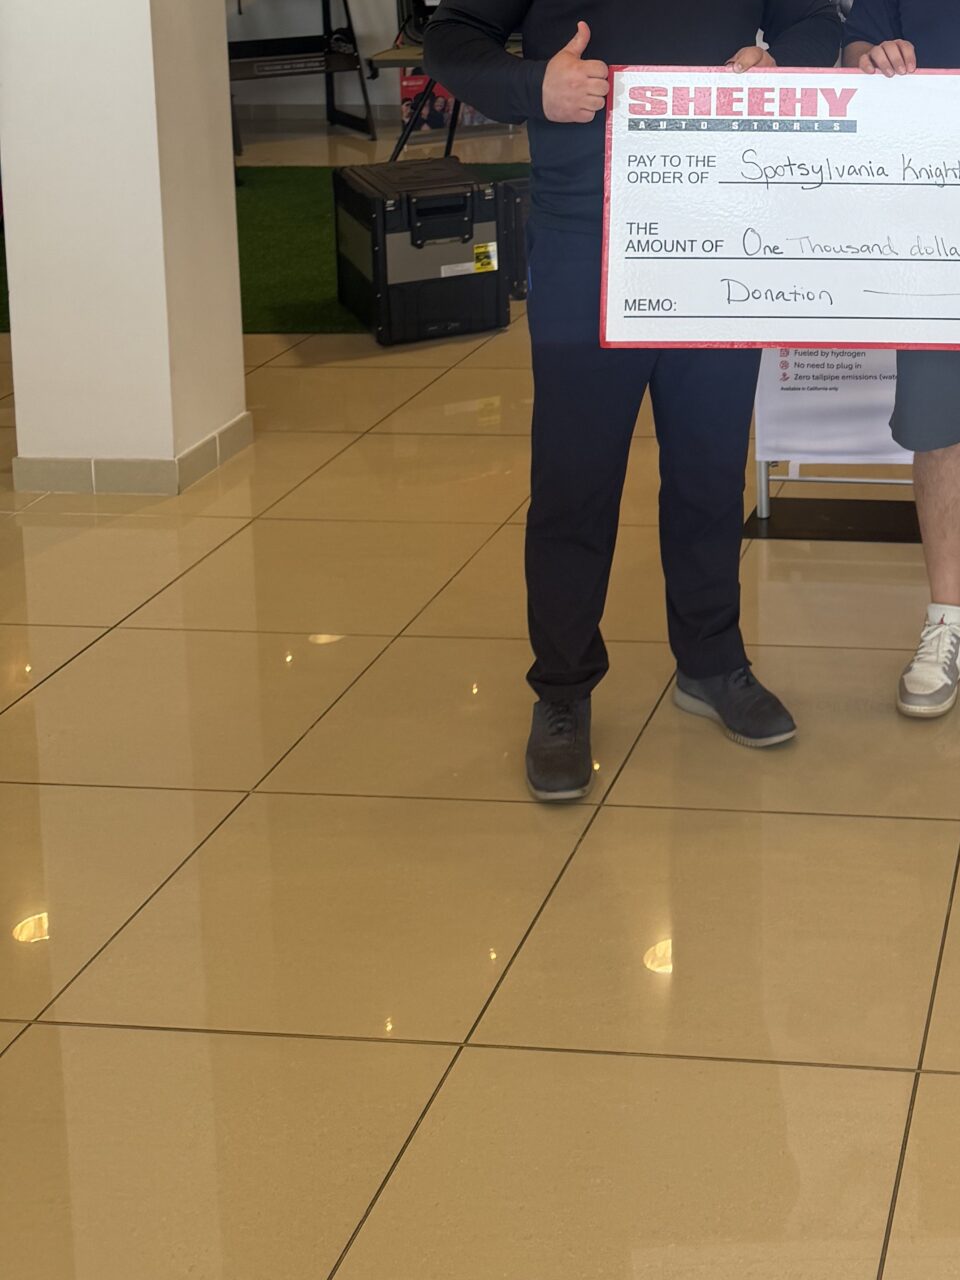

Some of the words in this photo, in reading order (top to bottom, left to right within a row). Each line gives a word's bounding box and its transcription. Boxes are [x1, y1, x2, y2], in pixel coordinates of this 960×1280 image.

[628, 86, 858, 117] SHEEHY
[638, 121, 708, 130] AUTO
[732, 122, 841, 132] STORES
[628, 155, 656, 168] PAY
[660, 155, 681, 168] TO
[688, 155, 717, 168] THE
[741, 149, 889, 190] Spotsylvania
[628, 172, 683, 184] ORDER
[687, 172, 709, 184] OF
[626, 222, 659, 235] THE
[625, 239, 697, 253] AMOUNT
[701, 239, 724, 253] OF
[743, 228, 784, 256] One
[786, 235, 899, 256] Thousand
[721, 278, 833, 305] Donation
[624, 299, 677, 312] MEMO:
[794, 349, 819, 357] Fueled
[821, 350, 830, 358] by
[831, 350, 866, 358] hydrogen
[836, 362, 853, 370] plug
[812, 373, 839, 382] tailpipe
